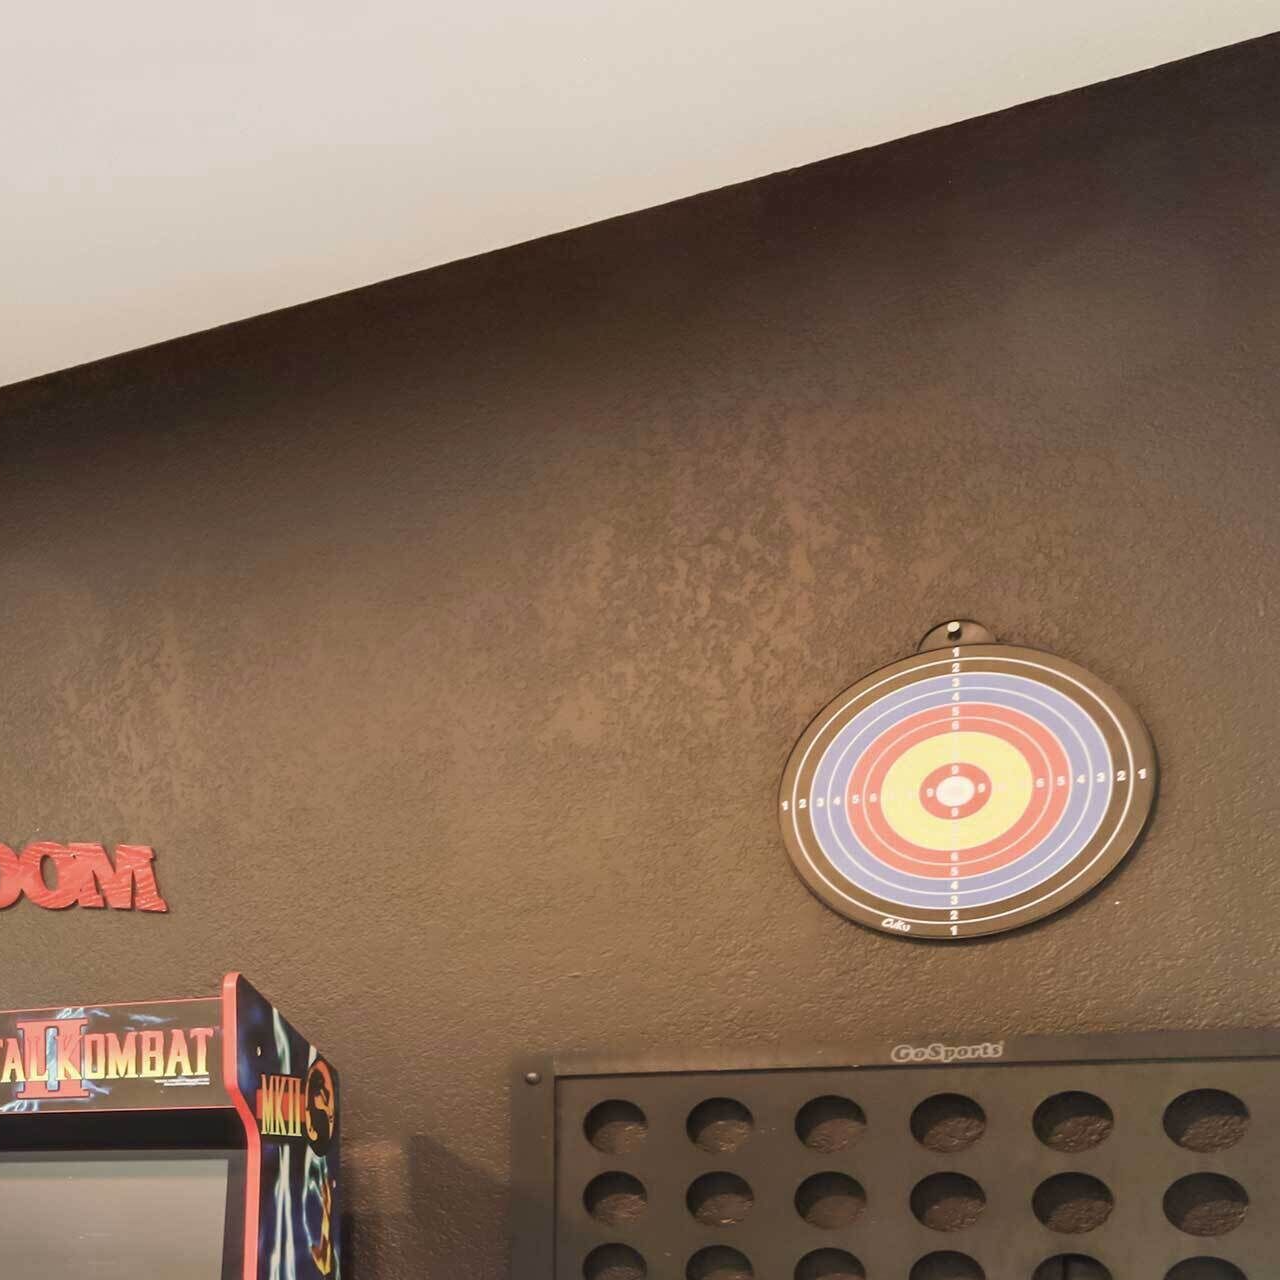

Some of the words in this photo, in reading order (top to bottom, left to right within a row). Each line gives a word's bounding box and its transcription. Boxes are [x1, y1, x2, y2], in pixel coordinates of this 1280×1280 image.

[1056, 776, 1066, 786] 5
[1077, 774, 1086, 784] 4
[1096, 772, 1106, 783] 3
[1116, 770, 1127, 782] 2
[1137, 768, 1147, 780] 1
[782, 800, 789, 811] 1
[798, 798, 807, 809] 2
[816, 797, 825, 807] 3
[832, 796, 841, 806] 4
[950, 881, 959, 890] 4
[950, 895, 959, 905] 3
[950, 910, 959, 920] 2
[950, 925, 959, 936] 1
[56, 1027, 215, 1080] KOMBAT
[891, 1042, 1003, 1063] GoSports
